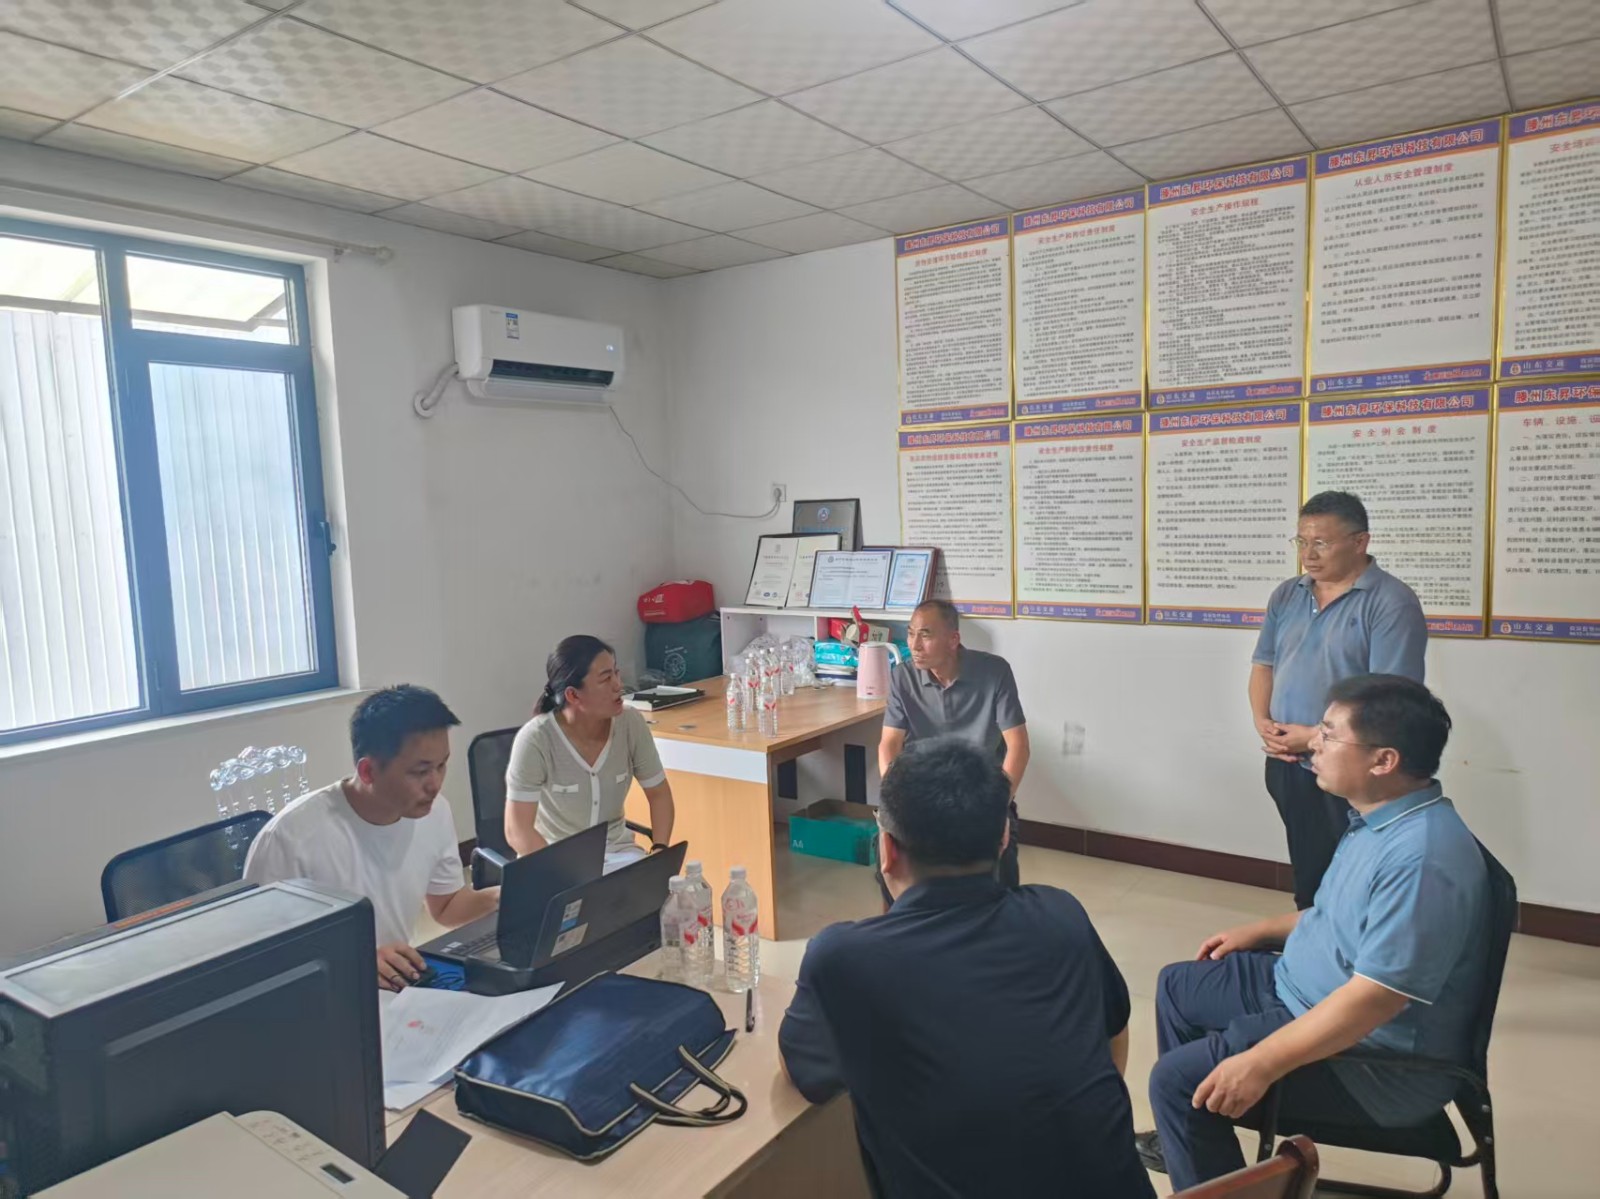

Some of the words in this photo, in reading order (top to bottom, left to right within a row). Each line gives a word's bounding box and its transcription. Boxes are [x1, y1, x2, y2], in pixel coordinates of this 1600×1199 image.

[1328, 129, 1484, 169] 滕州东昇环保科技有限公司
[1354, 162, 1454, 187] 从业人员安全管理制度
[1321, 395, 1474, 418] 滕州东昇环保科技有限公司
